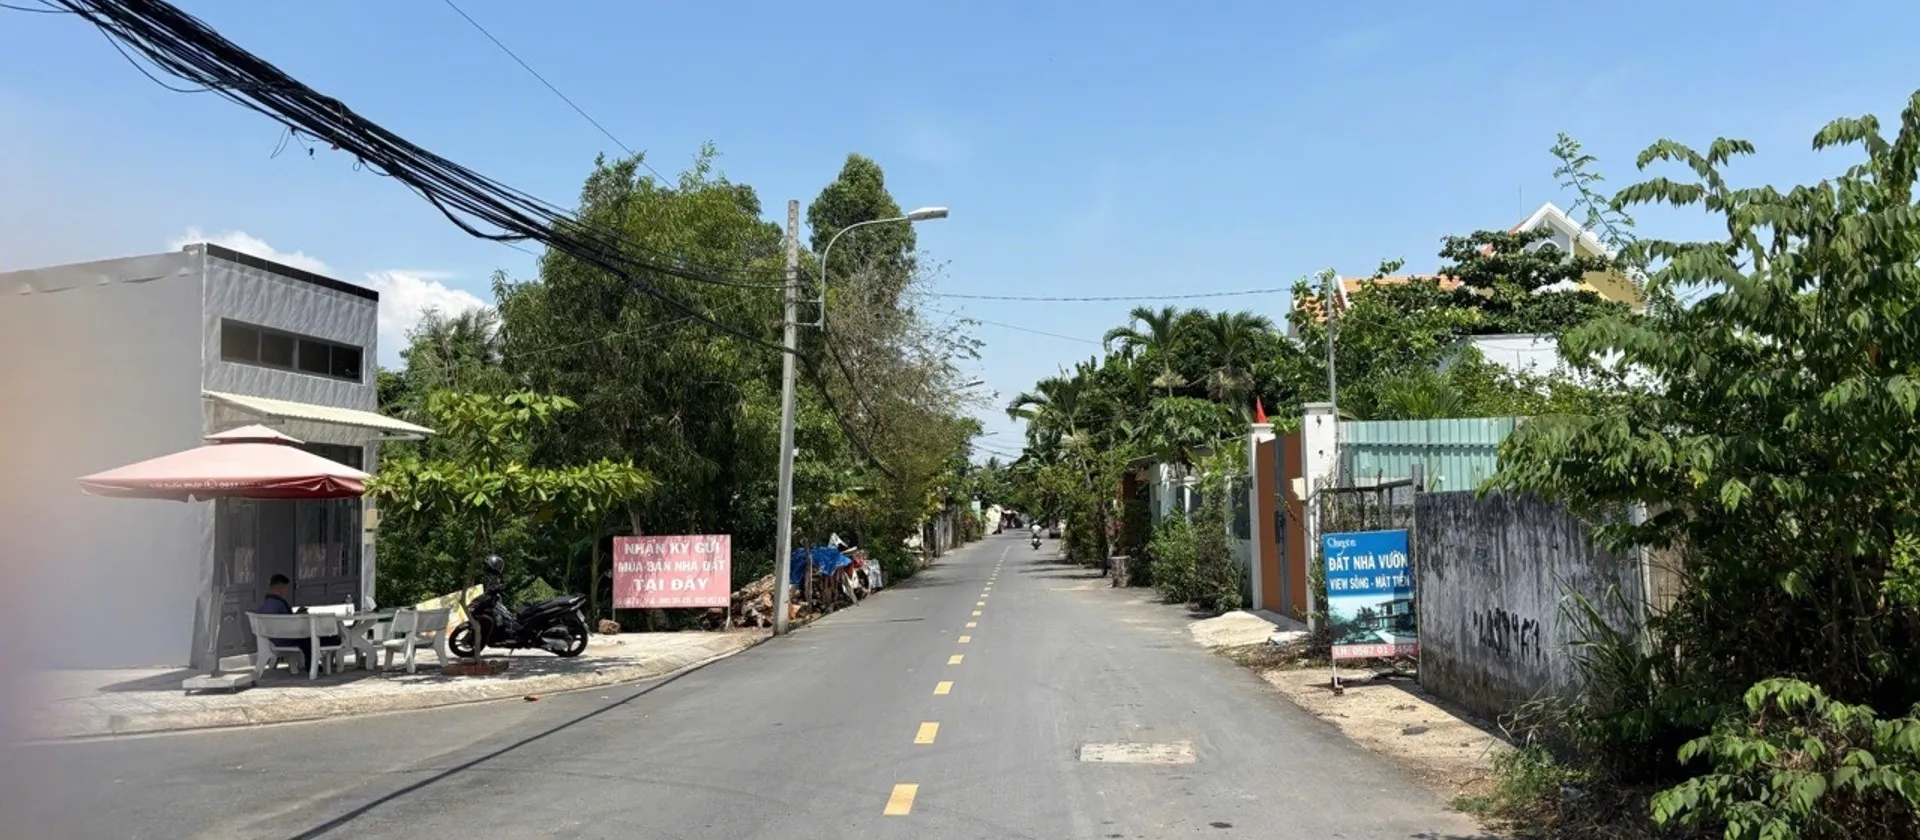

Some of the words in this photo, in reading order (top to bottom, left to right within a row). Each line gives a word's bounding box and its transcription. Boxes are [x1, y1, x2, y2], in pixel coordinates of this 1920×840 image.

[1328, 549, 1349, 571] ĐẤT
[1353, 550, 1375, 570] NHÀ
[1378, 550, 1408, 569] VƯỜN
[634, 578, 664, 594] TẠI
[671, 576, 708, 591] ĐÂY
[1329, 577, 1348, 590] VIEW
[1350, 574, 1369, 589] SÔNG
[1375, 573, 1391, 591] MẶT
